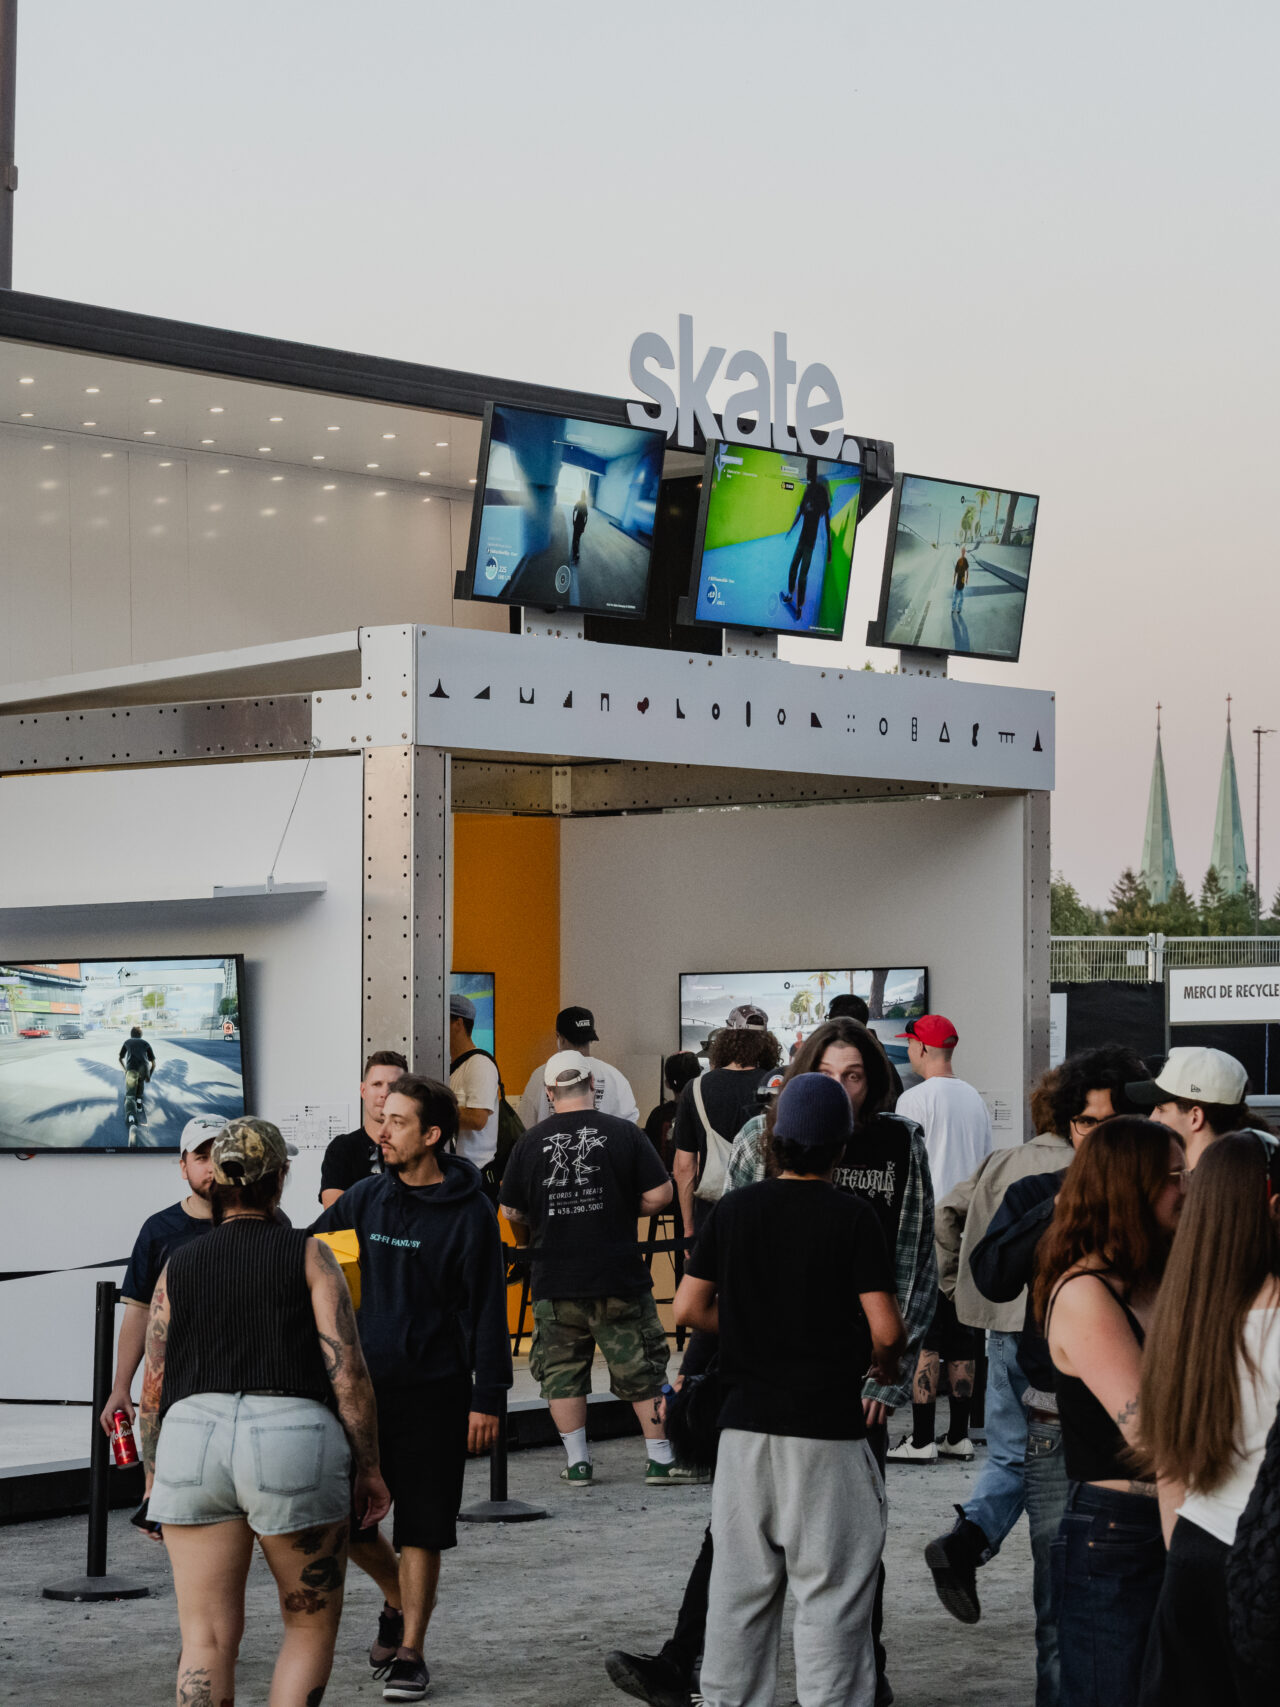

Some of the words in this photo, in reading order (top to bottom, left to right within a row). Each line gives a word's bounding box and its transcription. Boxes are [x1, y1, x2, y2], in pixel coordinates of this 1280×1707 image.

[1183, 985, 1217, 1000] MERCI
[1219, 984, 1233, 999] DE
[1235, 983, 1280, 998] RECYCLE
[576, 1019, 591, 1028] VANS
[369, 1233, 390, 1244] SCI-FI
